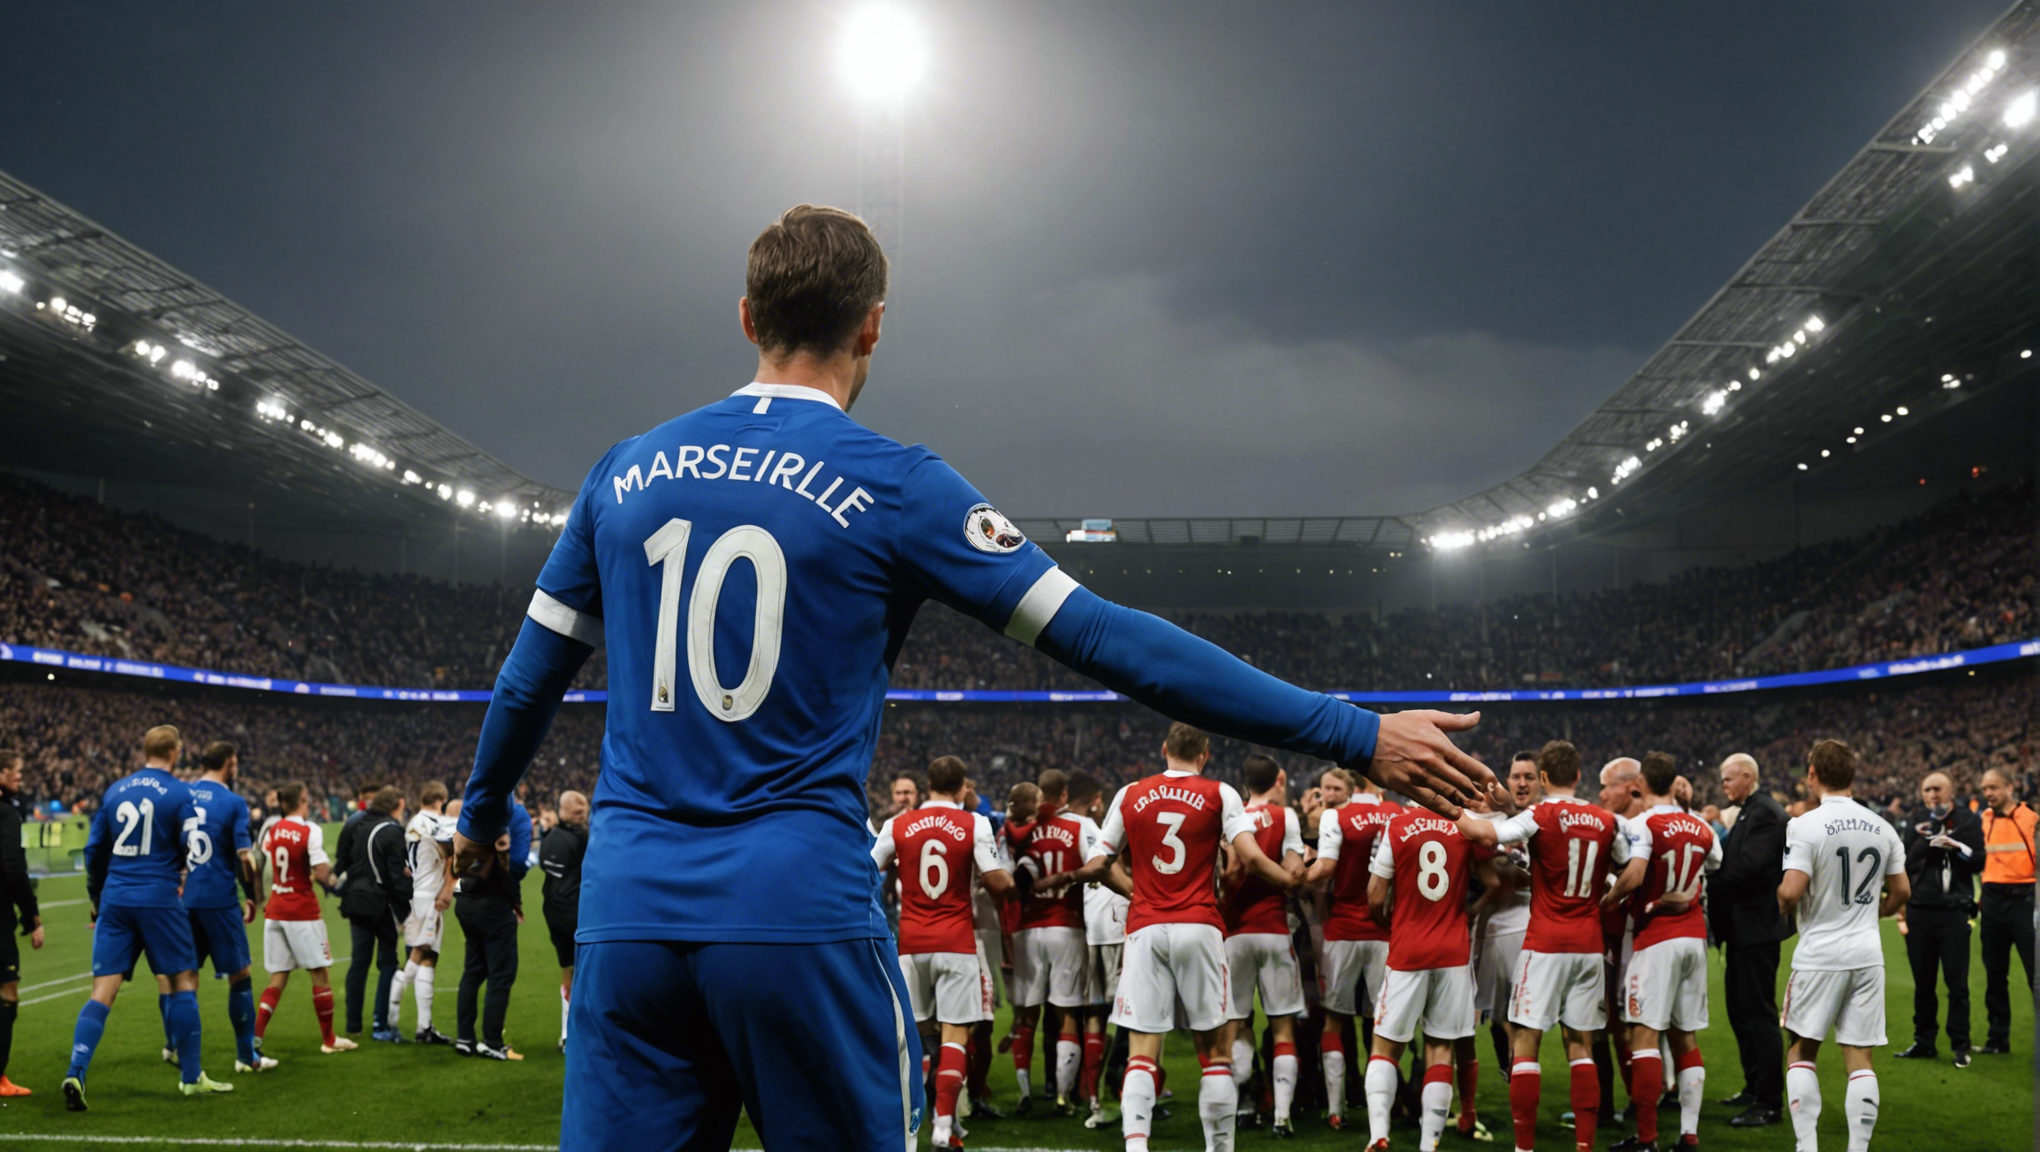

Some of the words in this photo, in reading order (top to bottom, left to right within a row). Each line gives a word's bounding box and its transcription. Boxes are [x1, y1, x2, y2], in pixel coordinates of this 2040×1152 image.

[613, 444, 875, 529] MARSEIRLLE
[643, 517, 788, 723] 10
[112, 797, 155, 856] 21
[1151, 811, 1187, 875] 3
[275, 845, 290, 884] 9
[919, 838, 949, 900] 6
[1417, 840, 1450, 902] 8
[1563, 837, 1599, 898] 11
[1836, 846, 1881, 906] 12
